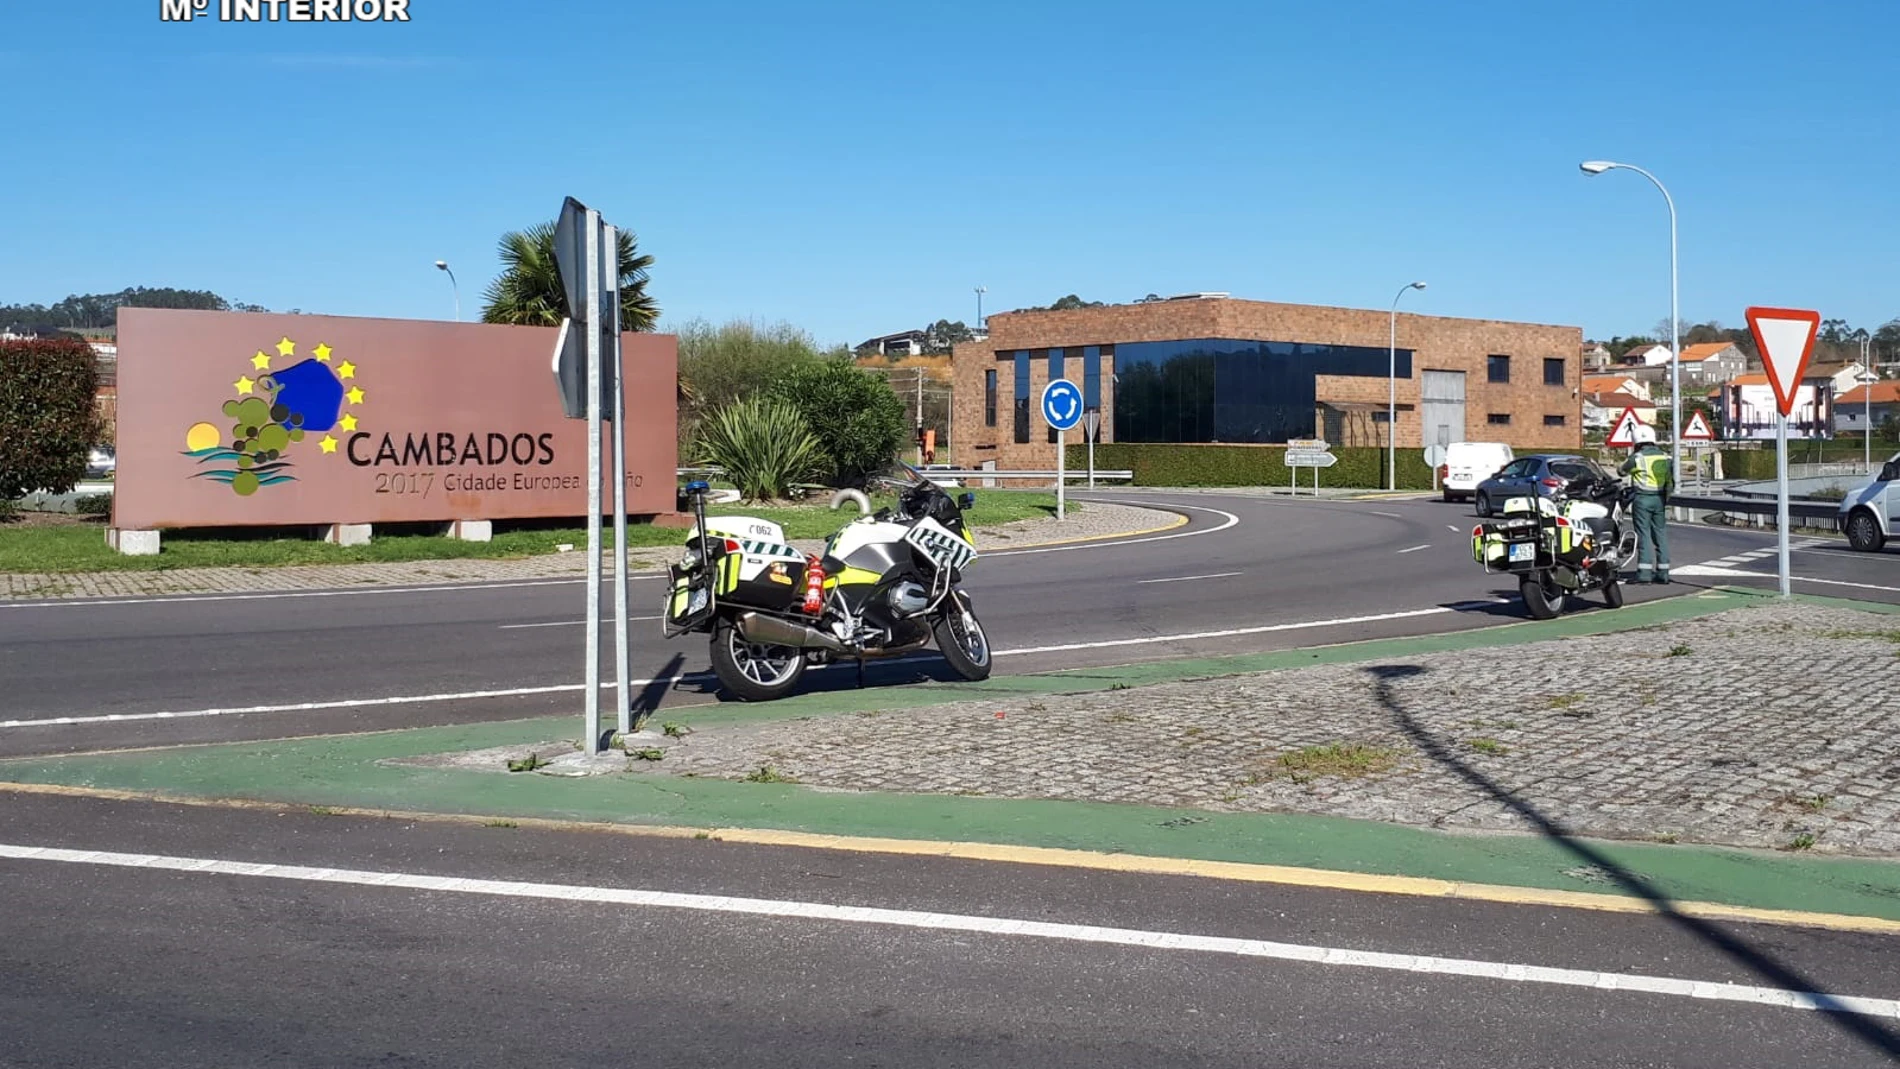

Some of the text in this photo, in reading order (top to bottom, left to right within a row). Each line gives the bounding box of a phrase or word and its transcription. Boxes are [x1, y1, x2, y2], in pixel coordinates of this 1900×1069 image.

[347, 431, 555, 467] CAMBADOS
[375, 472, 435, 500] 2017
[443, 472, 507, 491] Cidade
[513, 472, 580, 491] Europea
[756, 524, 773, 536] 062
